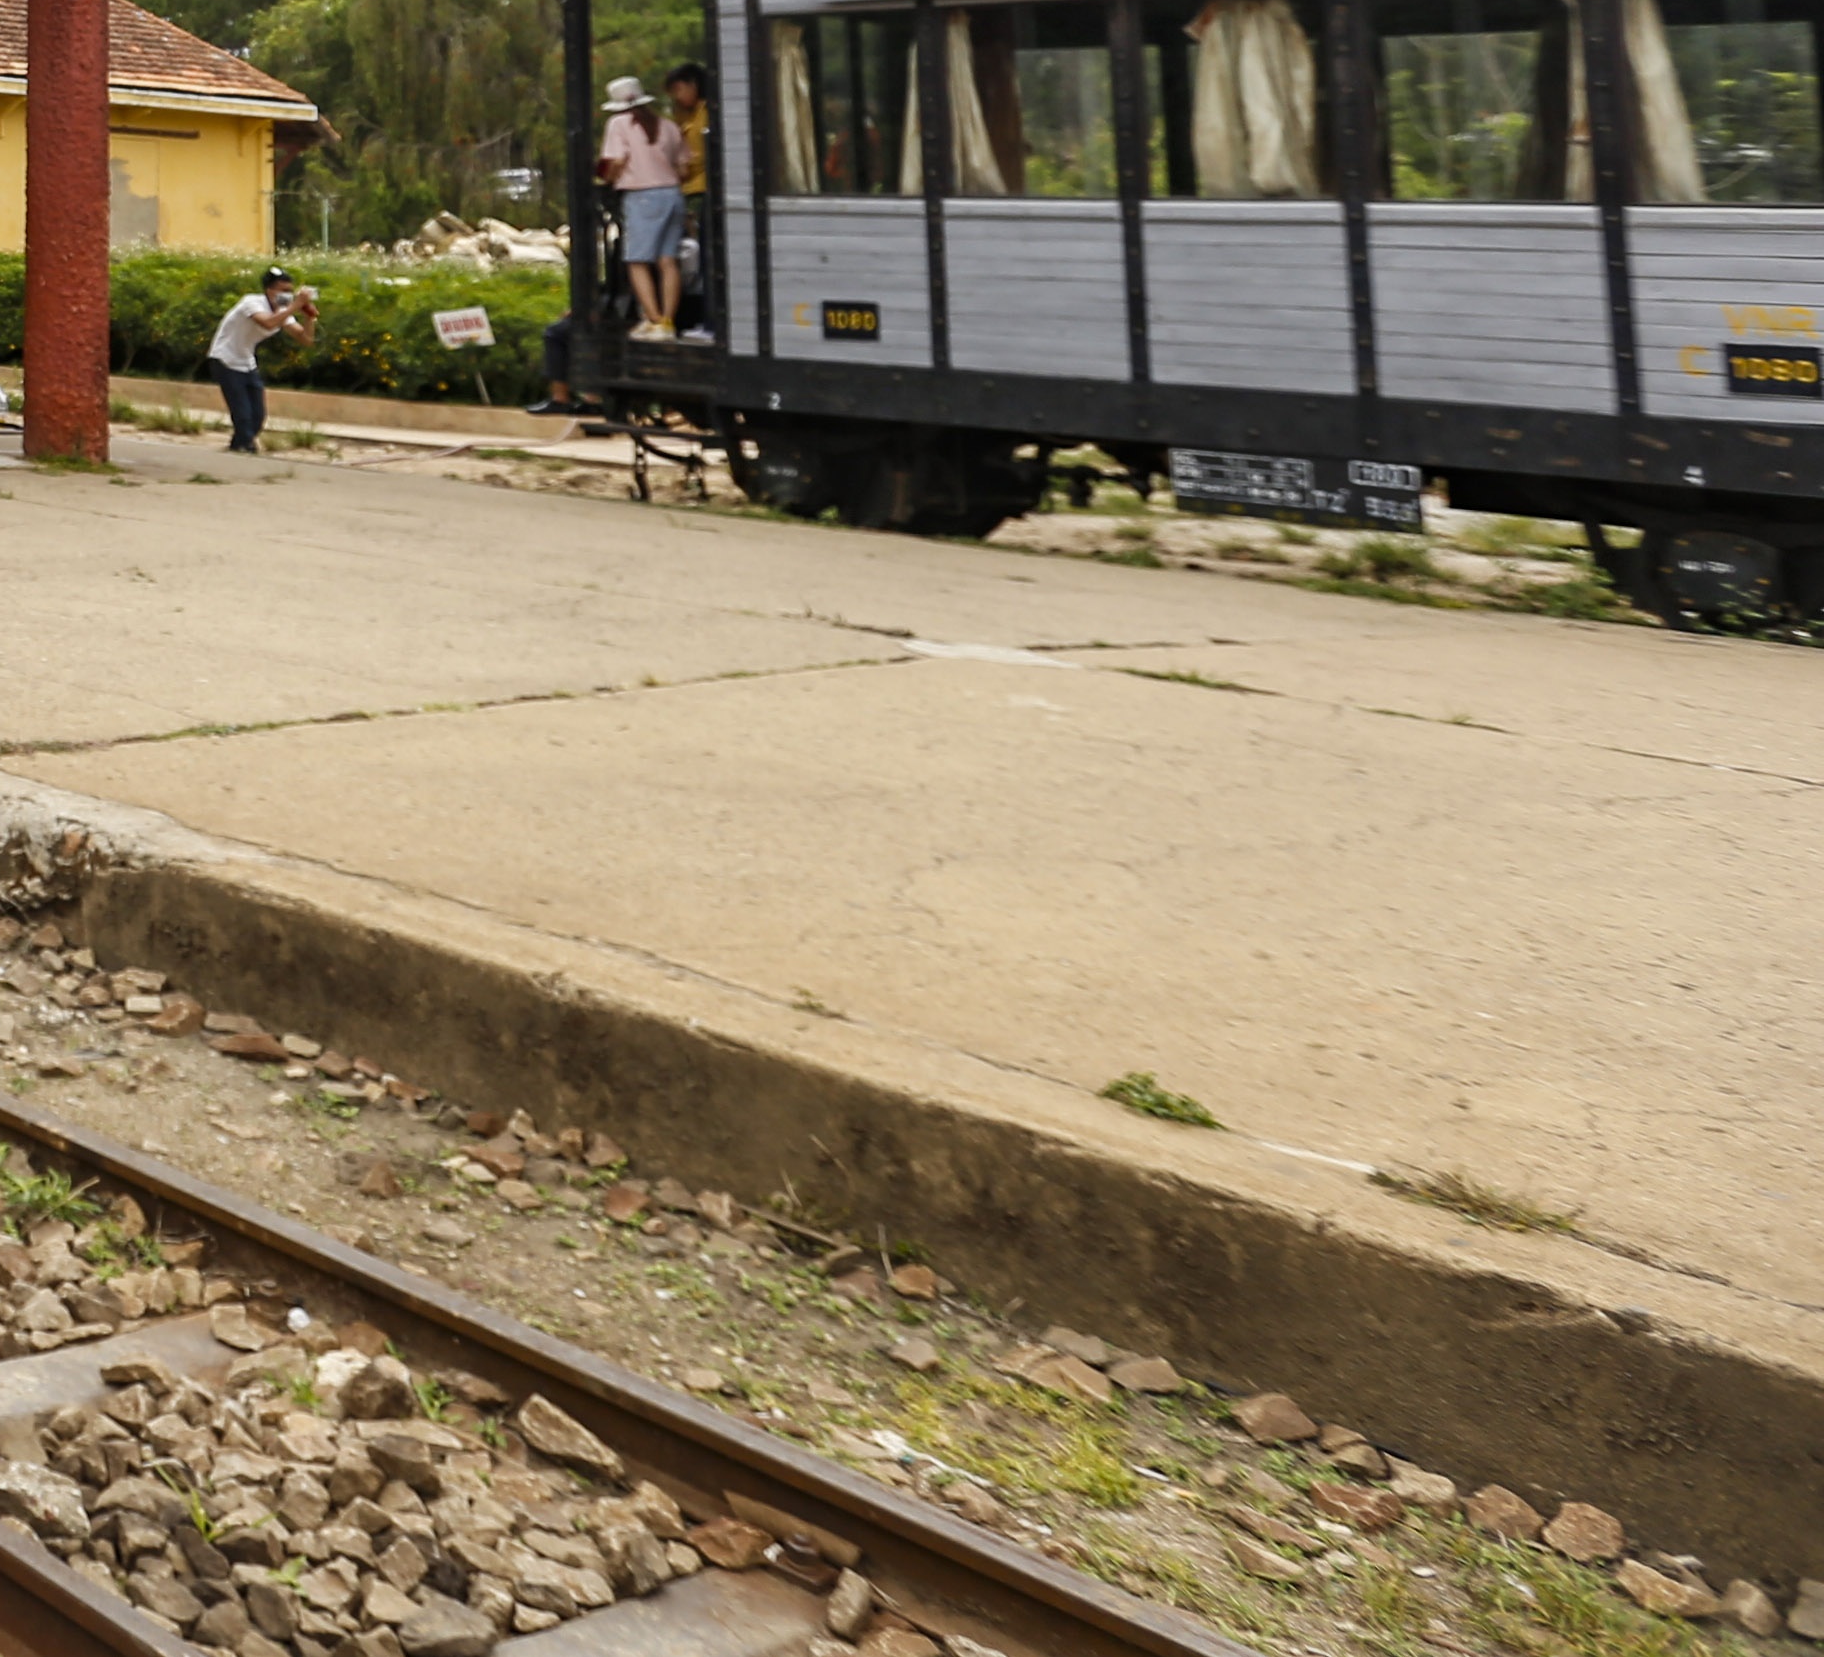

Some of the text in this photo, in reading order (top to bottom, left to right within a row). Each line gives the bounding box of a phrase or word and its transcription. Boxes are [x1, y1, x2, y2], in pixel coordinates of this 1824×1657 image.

[793, 303, 877, 331] C 1080
[1720, 304, 1821, 339] VNR
[1678, 345, 1819, 383] C 1080
